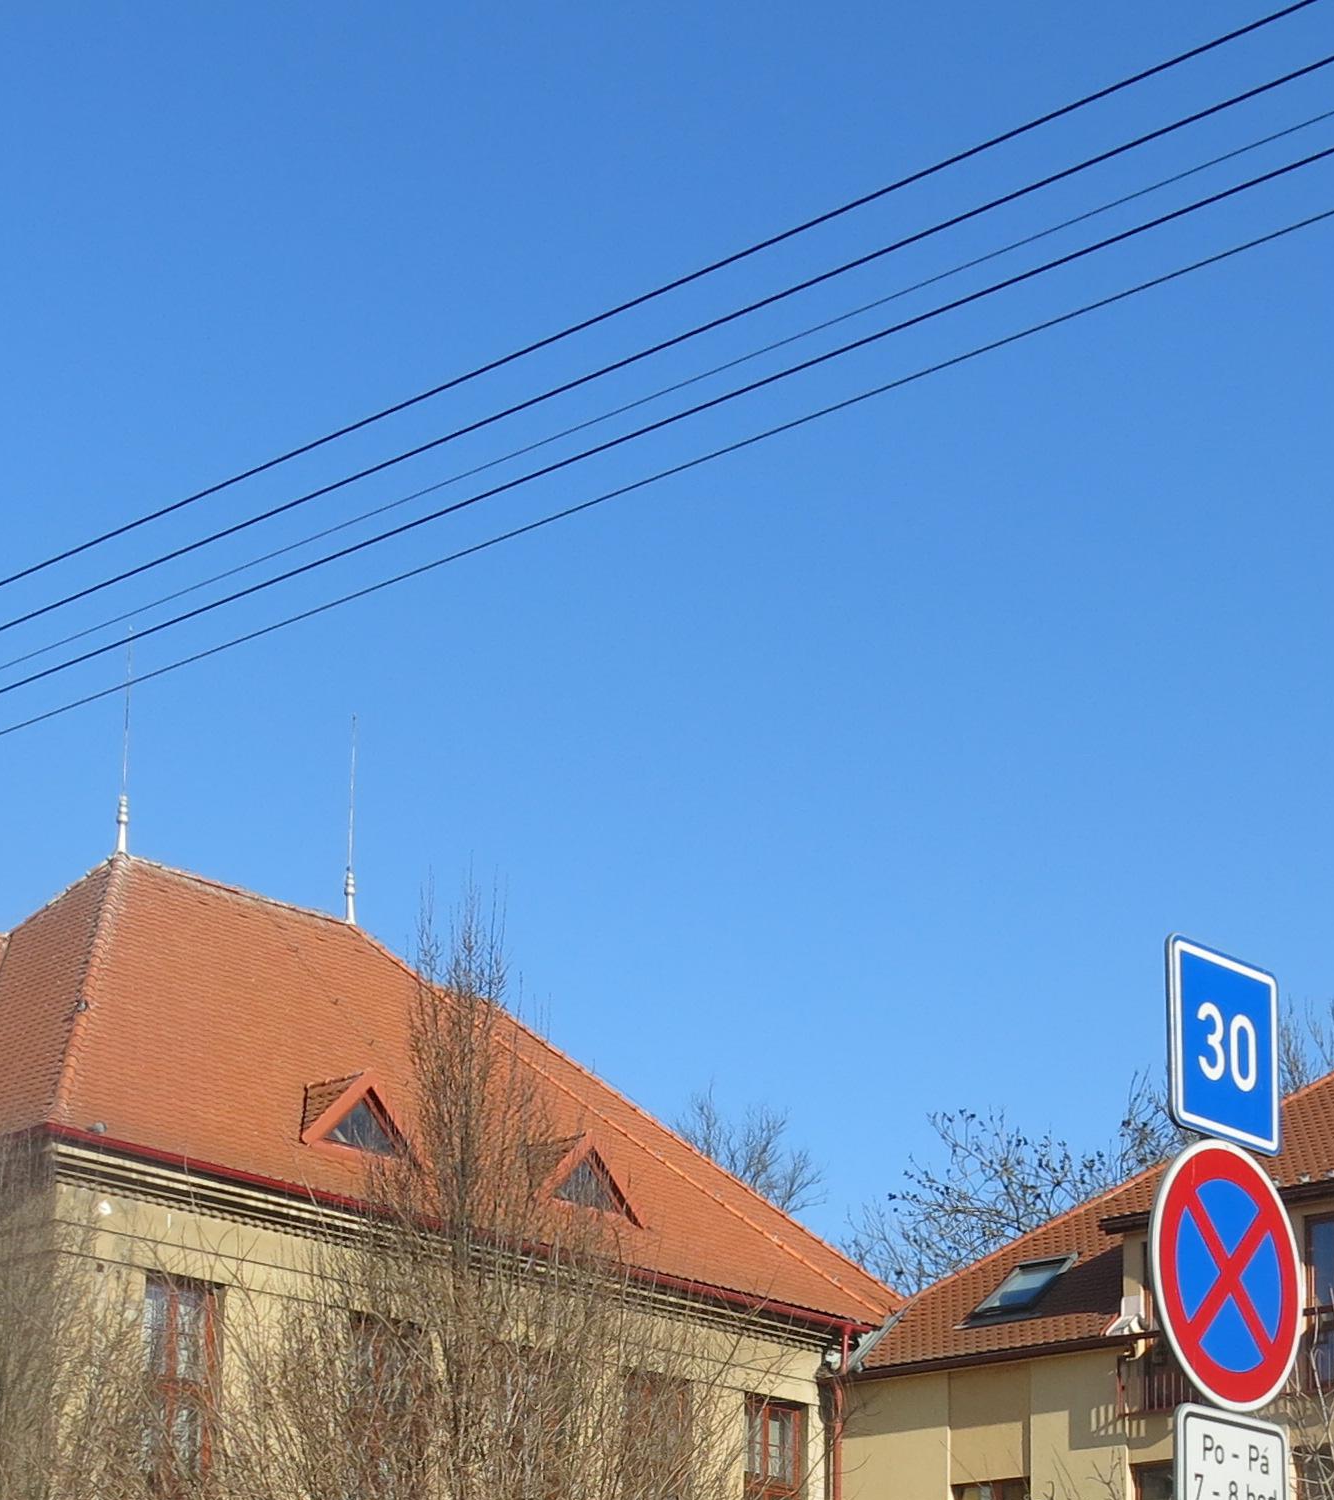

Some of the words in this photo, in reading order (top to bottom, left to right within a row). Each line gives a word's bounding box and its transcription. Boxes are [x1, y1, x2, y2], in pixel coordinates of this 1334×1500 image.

[1197, 1001, 1257, 1092] 30
[1202, 1434, 1225, 1465] Po
[1248, 1444, 1270, 1475] Pá
[1194, 1473, 1204, 1500] 7
